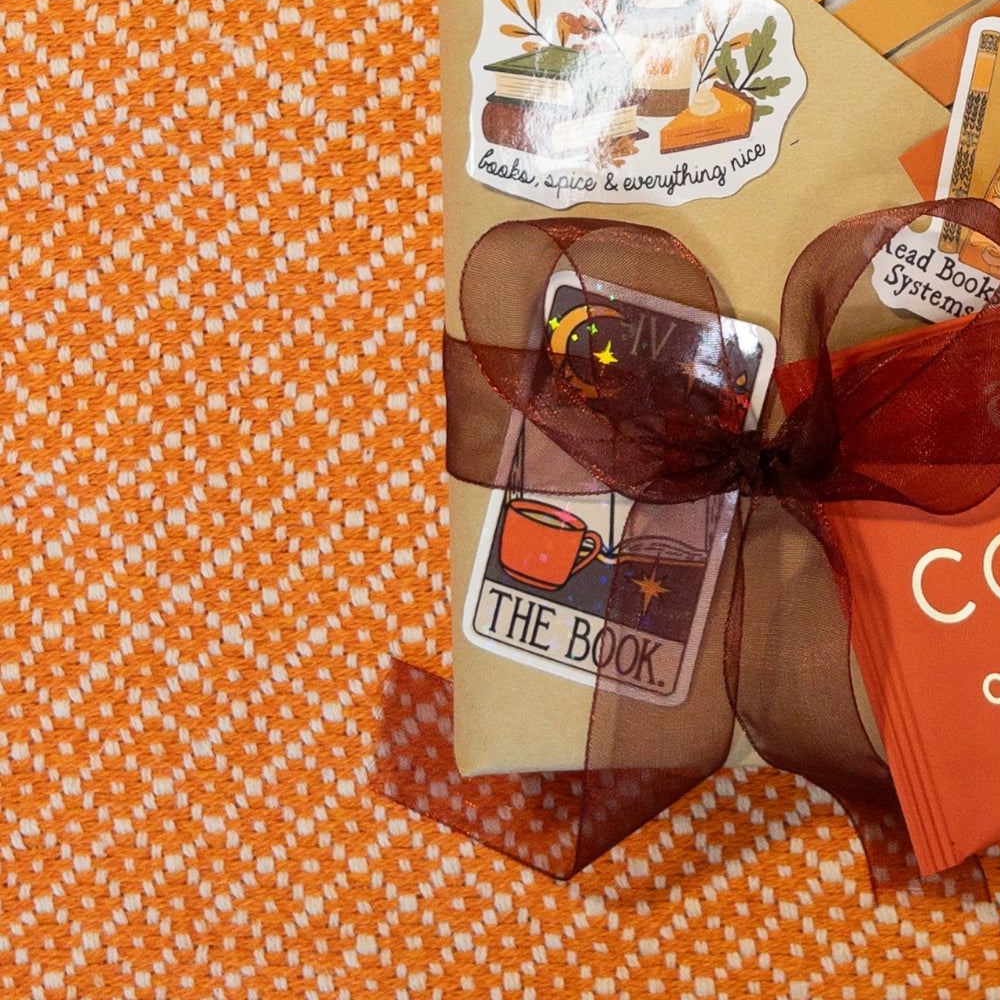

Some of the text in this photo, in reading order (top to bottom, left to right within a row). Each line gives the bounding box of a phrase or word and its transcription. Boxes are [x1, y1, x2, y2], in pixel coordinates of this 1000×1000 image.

[543, 173, 598, 199] spice
[604, 173, 619, 191] &
[623, 163, 727, 196] everything
[730, 143, 767, 172] nice
[884, 263, 975, 317] Systems
[489, 587, 669, 689] THE BOOK.
